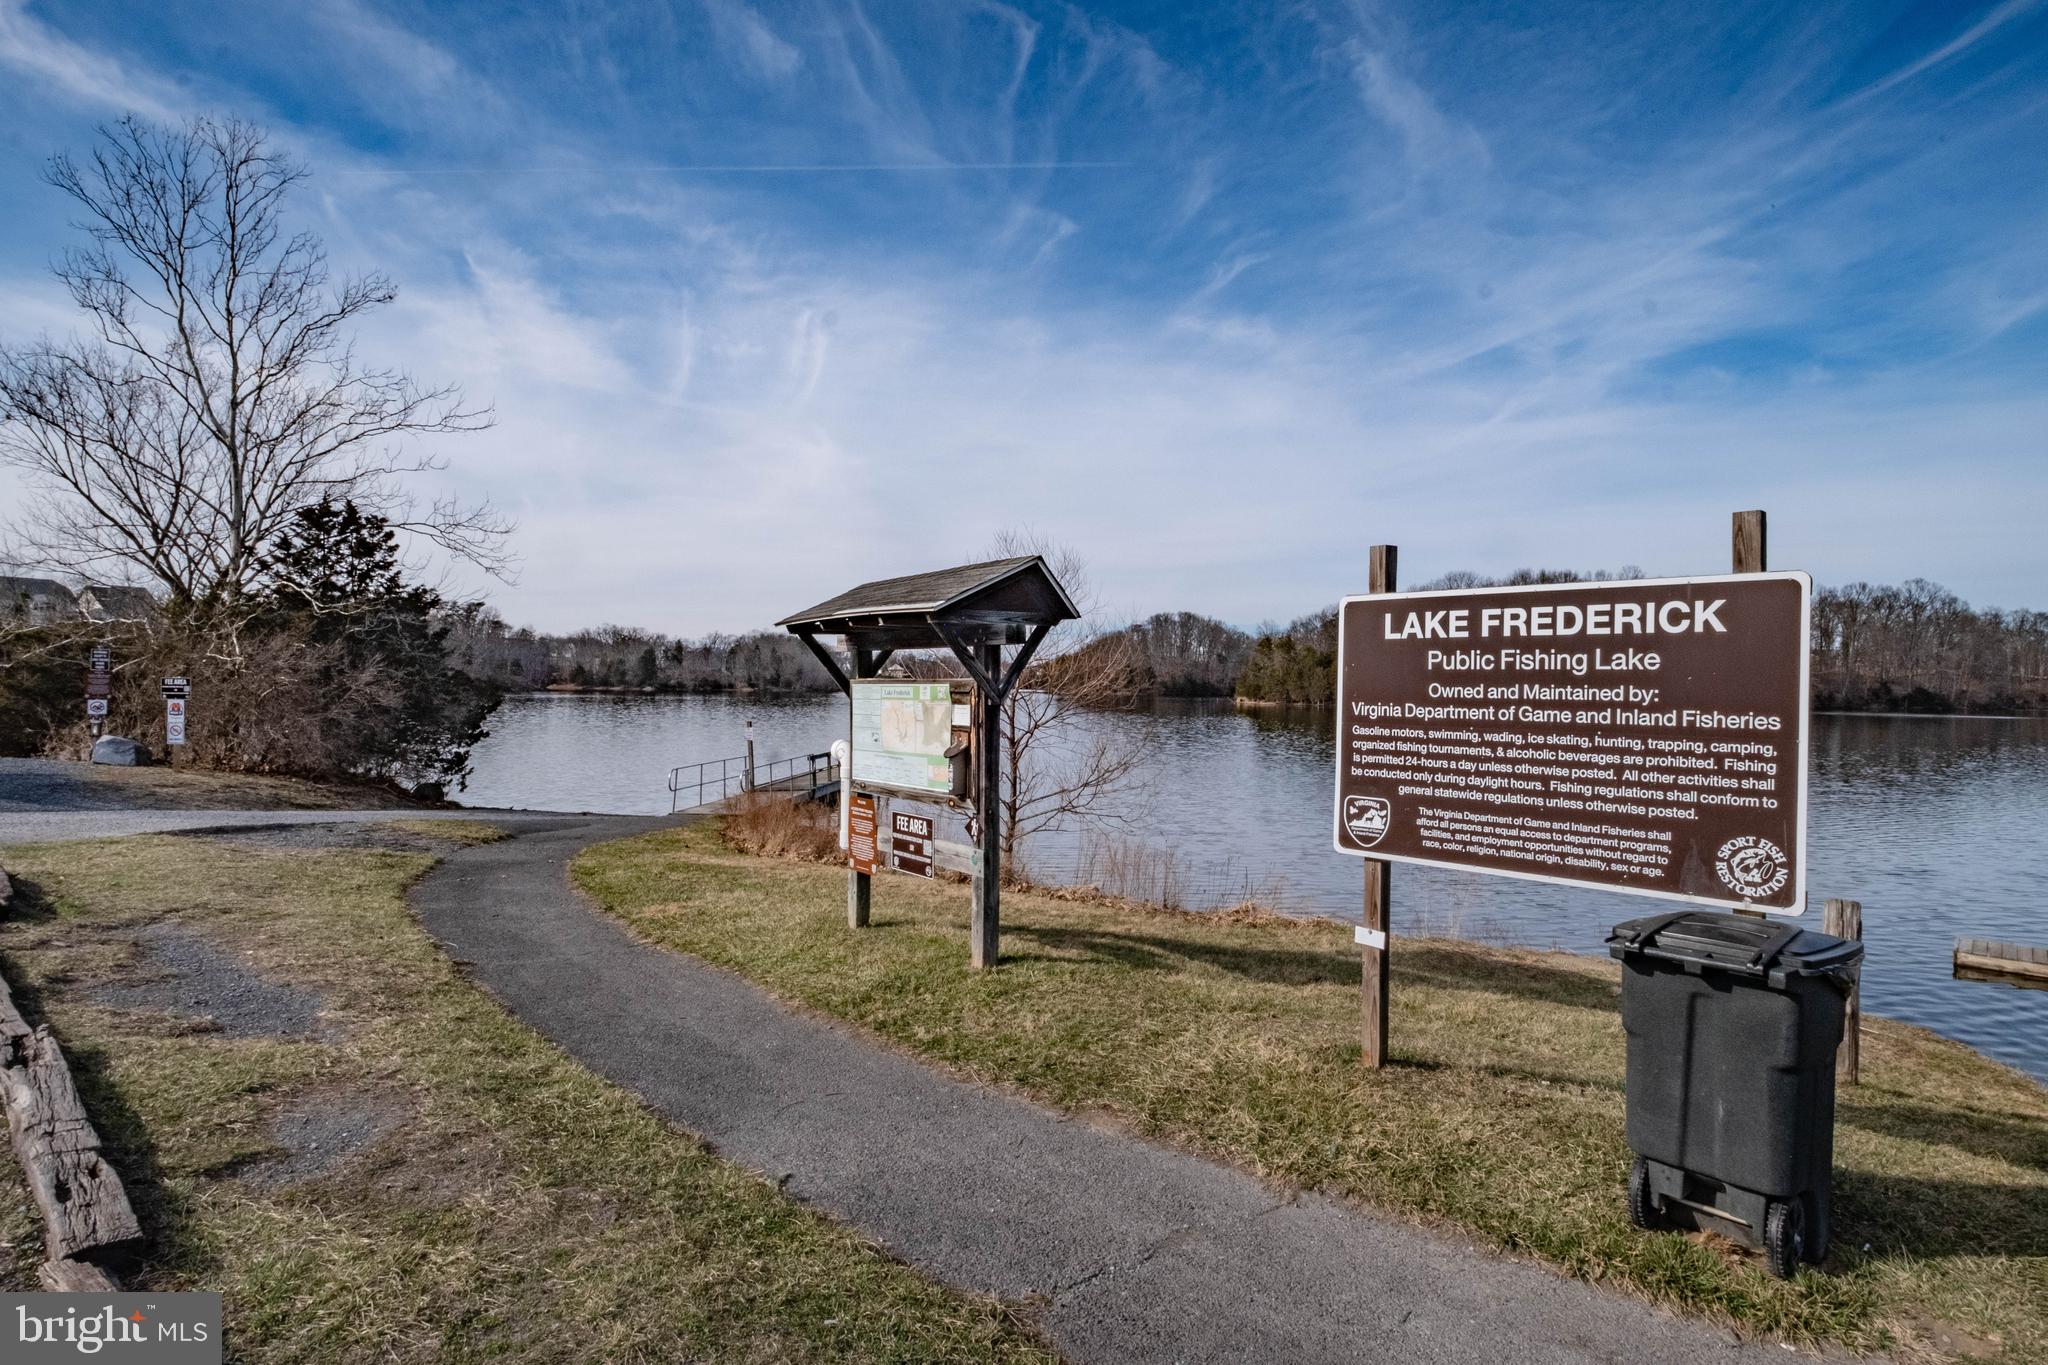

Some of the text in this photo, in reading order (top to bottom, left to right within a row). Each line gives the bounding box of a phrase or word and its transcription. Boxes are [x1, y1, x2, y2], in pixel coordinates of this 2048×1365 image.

[1384, 600, 1728, 639] LAKE FREDERICK
[1427, 649, 1661, 675] Public Fishing Lake
[1428, 684, 1659, 705] Owned and Maintained by:
[1351, 702, 1782, 730] Virginia Department of Game and Inland Fisheries
[1352, 726, 1778, 757] Gasoline motors, swimming, wading, ice skating, hunting, trapping, camping,
[1352, 741, 1777, 775] organized fishing tournaments, & alcoholic beverages are prohibited. Fishing
[1351, 766, 1778, 808] be conducted only during daylight hours. Fishing regulations shall conform to
[1353, 753, 1361, 762] is
[1362, 753, 1404, 765] permitted
[1405, 757, 1448, 768] 24-hours
[1458, 760, 1477, 772] day
[1478, 762, 1513, 772] unless
[1514, 764, 1570, 776] otherwise
[1571, 769, 1617, 779] posted.
[1622, 770, 1639, 781] All
[1640, 772, 1676, 783] other
[1677, 775, 1739, 788] activities
[1740, 778, 1775, 790] shall
[1398, 786, 1699, 819] general statewide regulations unless otherwise posted.
[896, 816, 928, 836] FEE AREA
[1416, 818, 1439, 827] afford
[1440, 818, 1449, 828] all
[1450, 822, 1482, 832] persons
[1495, 828, 1518, 836] equal
[1520, 831, 1551, 839] access
[1552, 833, 1562, 841] to
[1563, 834, 1618, 847] department
[1620, 842, 1672, 854] programs,
[1418, 807, 1433, 816] The
[1434, 809, 1462, 819] Virginia
[1464, 812, 1512, 824] Department
[1524, 818, 1551, 828] Game
[1571, 823, 1600, 833] Inland
[1602, 826, 1646, 838] Fisheries
[1648, 831, 1671, 840] shall
[1420, 828, 1453, 840] facilities,
[1471, 835, 1523, 847] employment
[1524, 842, 1584, 854] opportunities
[1585, 848, 1621, 859] without
[1623, 851, 1656, 863] regard
[1657, 856, 1668, 864] to
[1422, 841, 1442, 849] race,
[1442, 842, 1465, 852] color,
[1466, 844, 1499, 856] religion,
[1500, 850, 1534, 860] national
[1535, 853, 1563, 864] origin,
[1564, 857, 1609, 870] disability,
[1630, 865, 1641, 873] or
[1642, 868, 1664, 877] age.
[1717, 836, 1788, 864] SPORT FISH
[1716, 862, 1788, 897] RESTORATION
